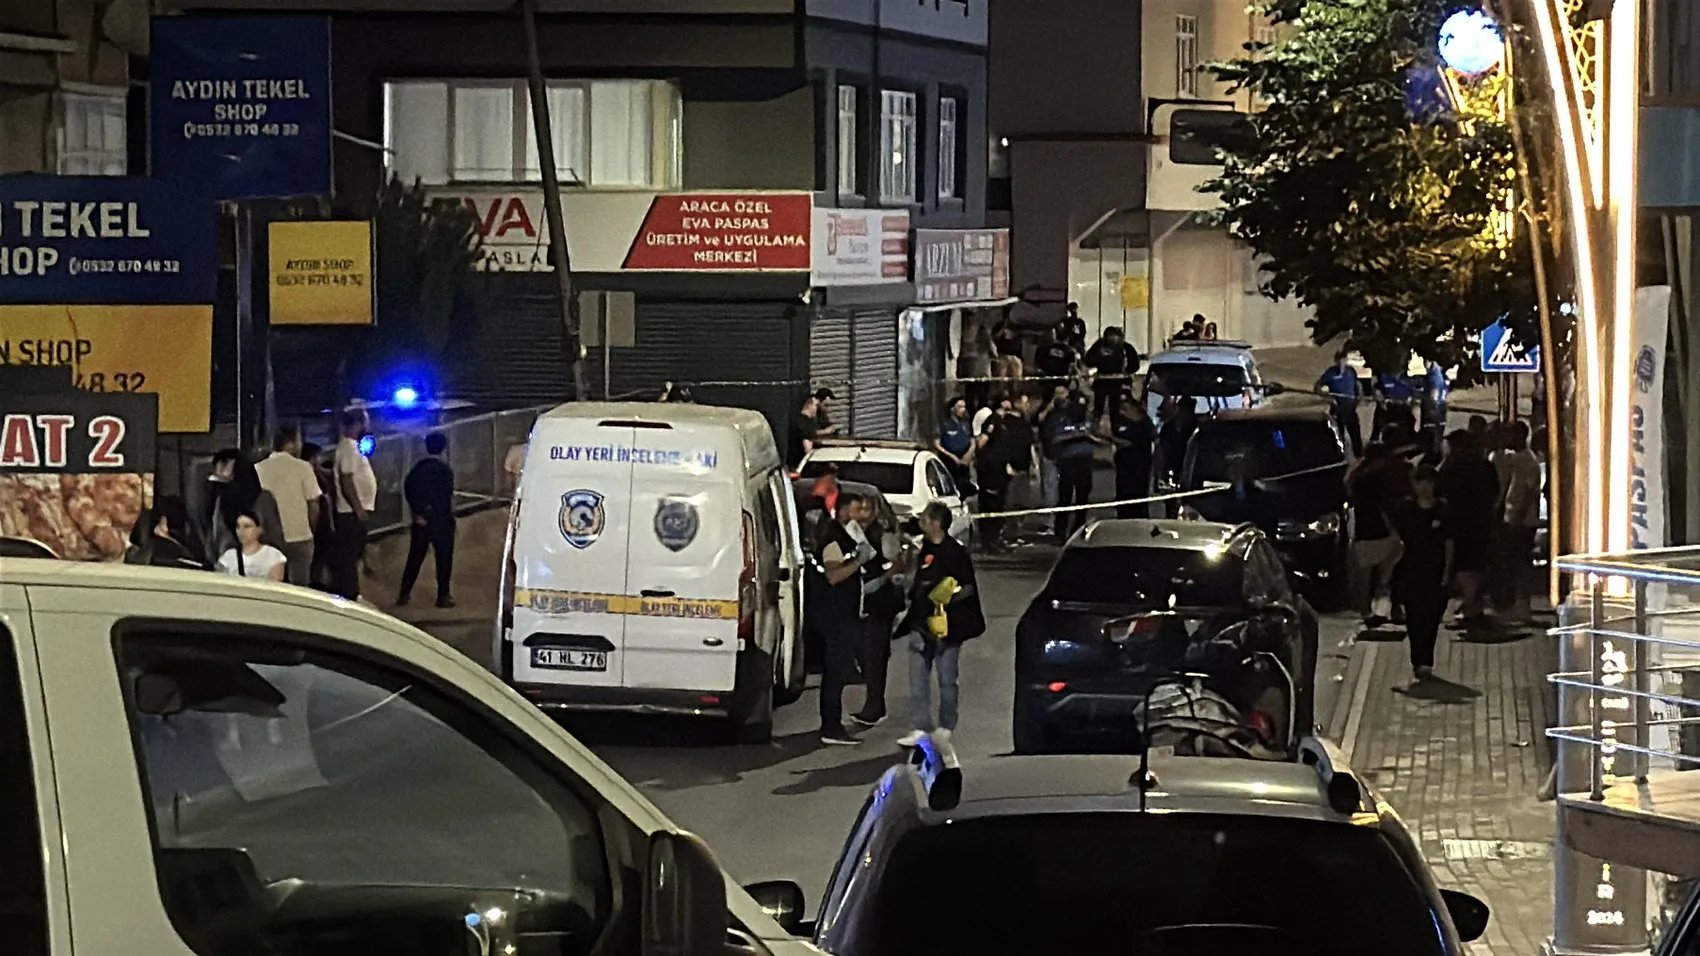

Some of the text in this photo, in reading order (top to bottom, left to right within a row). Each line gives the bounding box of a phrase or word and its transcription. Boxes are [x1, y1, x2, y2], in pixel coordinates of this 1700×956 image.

[172, 80, 310, 99] AYDIN TEKEL
[214, 104, 267, 120] SHOP
[680, 199, 772, 213] ARACA ÖZEL
[14, 201, 150, 237] TEKEL
[682, 218, 769, 229] EVA PASPAS
[646, 232, 806, 246] ÜRETİM ve UYGULAMA
[694, 249, 757, 263] MERKEZİ
[19, 340, 91, 365] SHOP
[0, 414, 125, 467] AT 2
[550, 446, 582, 460] OLAY
[585, 444, 614, 461] YERİ
